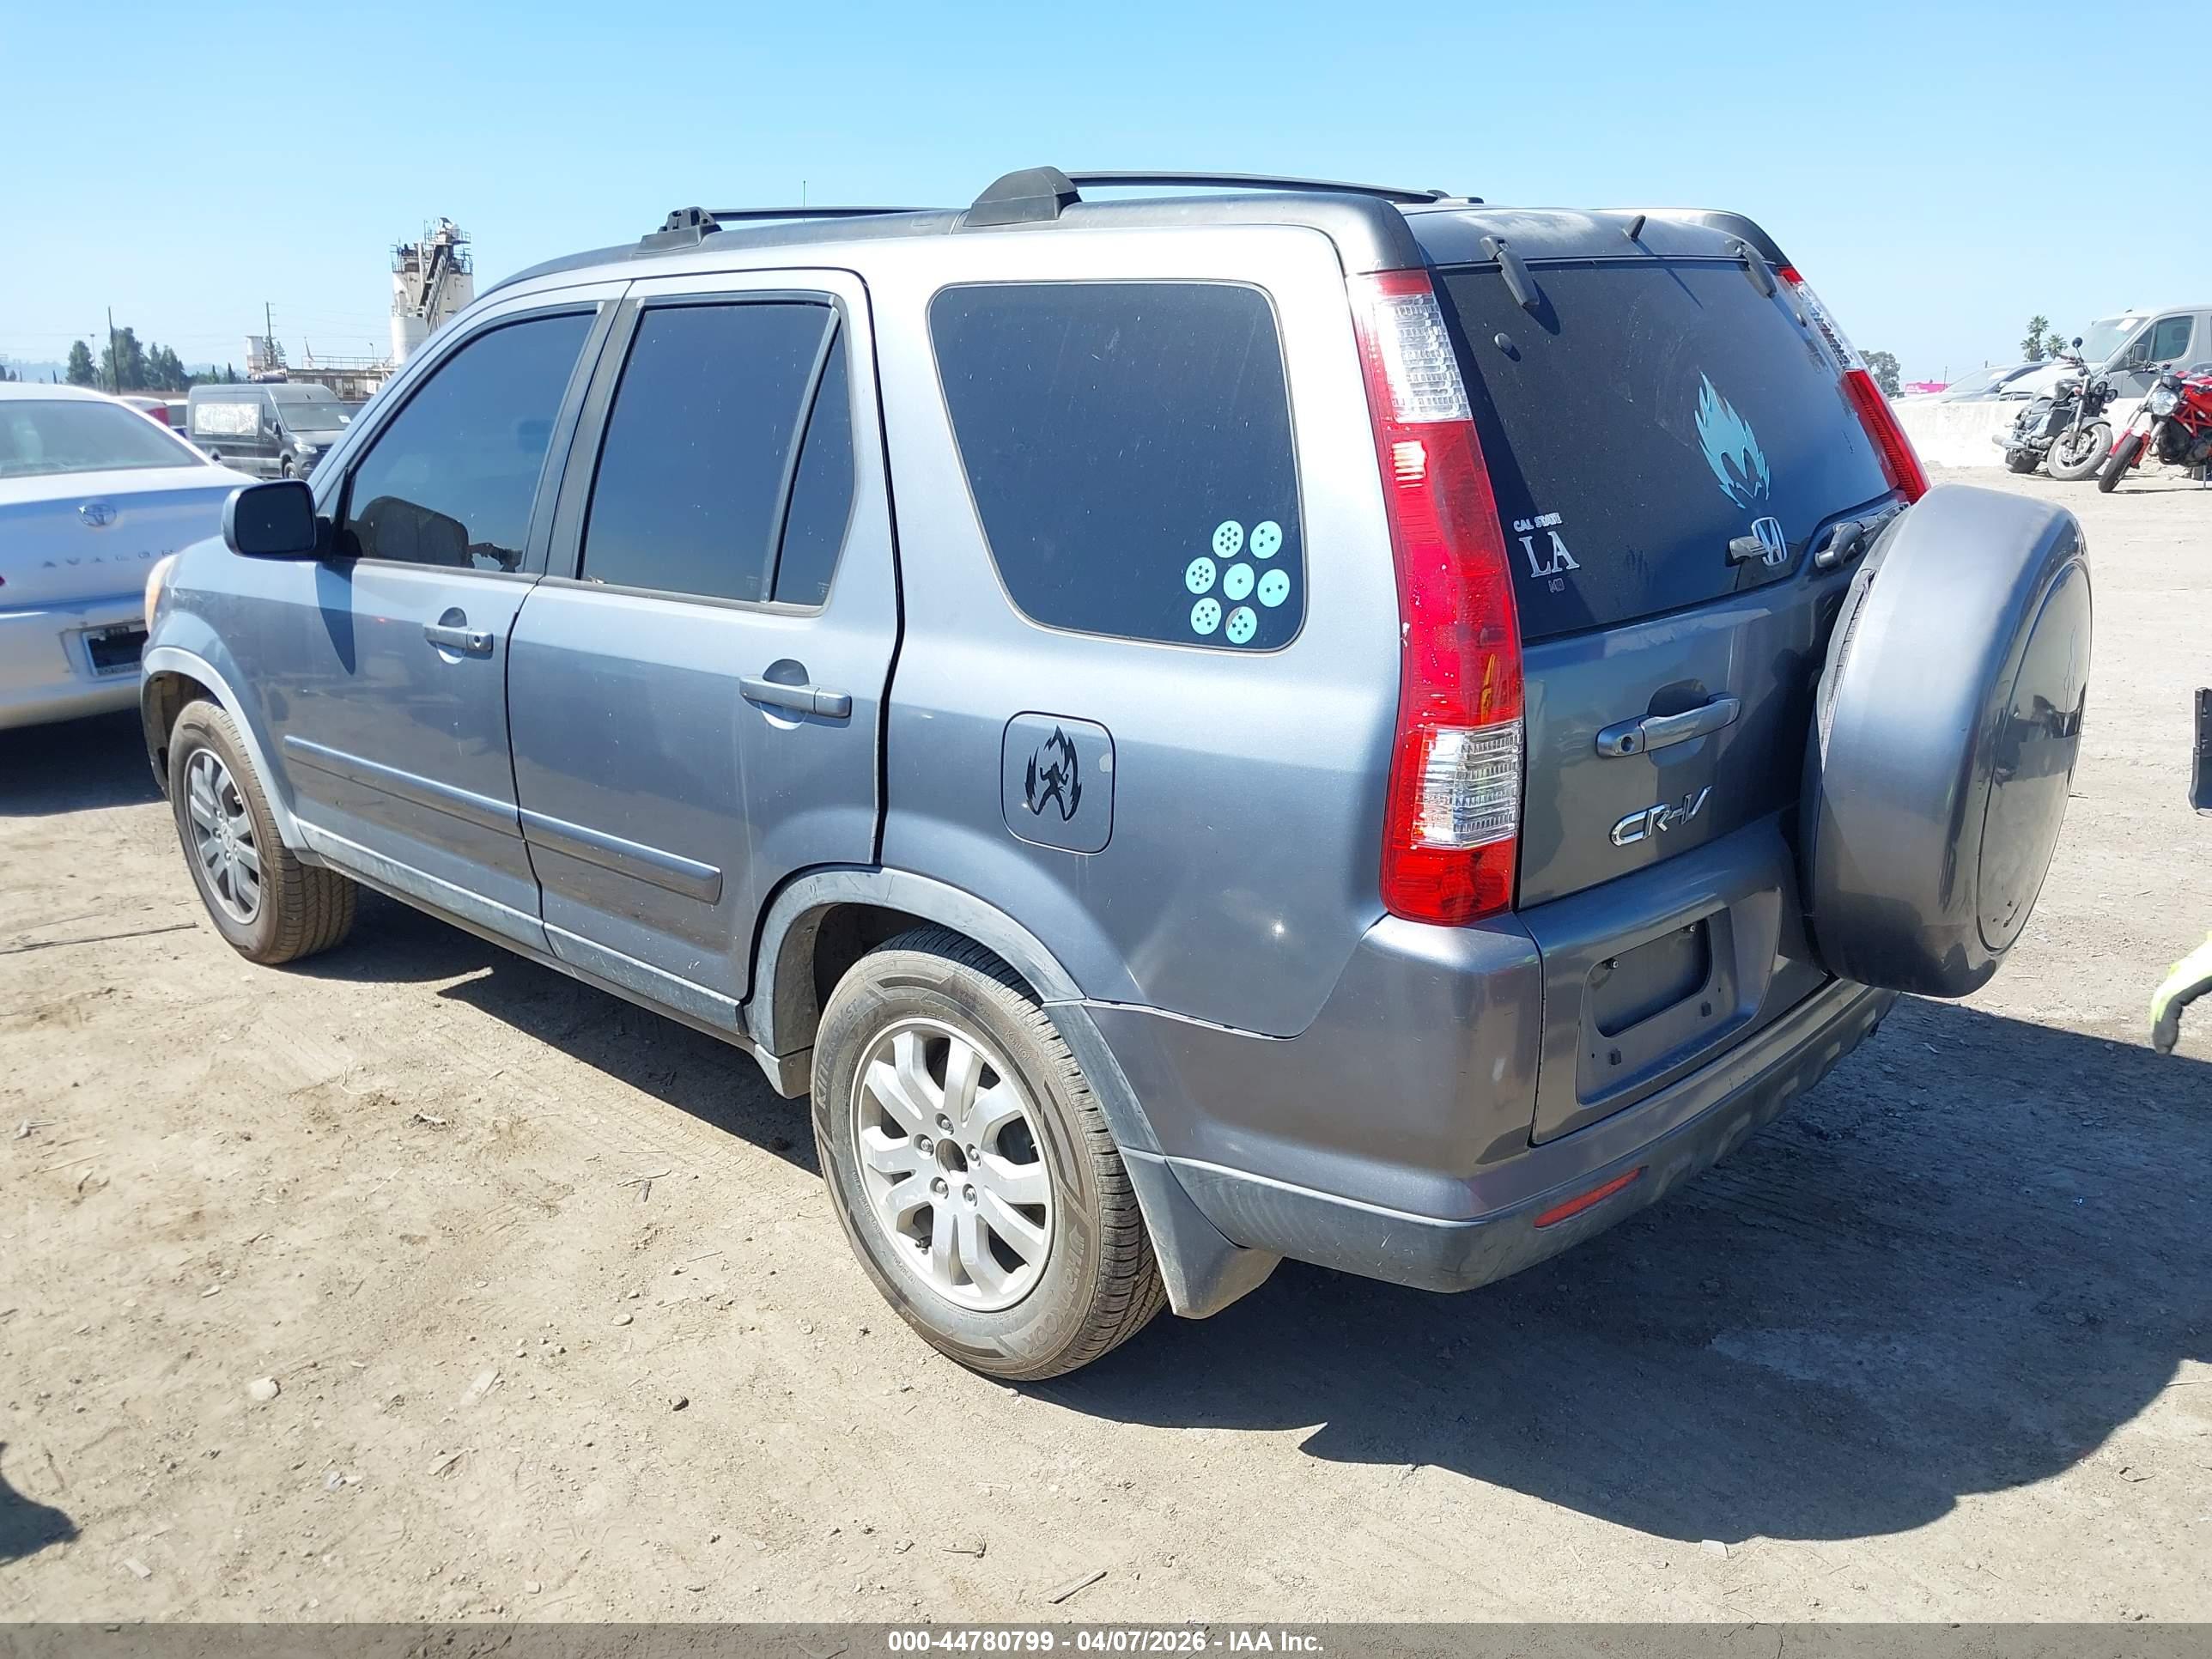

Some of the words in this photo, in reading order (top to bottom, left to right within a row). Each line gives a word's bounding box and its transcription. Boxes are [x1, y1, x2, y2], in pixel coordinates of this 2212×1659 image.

[1513, 519, 1534, 532] CAL
[1534, 512, 1563, 528] STATE
[1518, 531, 1580, 578] LA
[1610, 785, 1713, 847] CR-V
